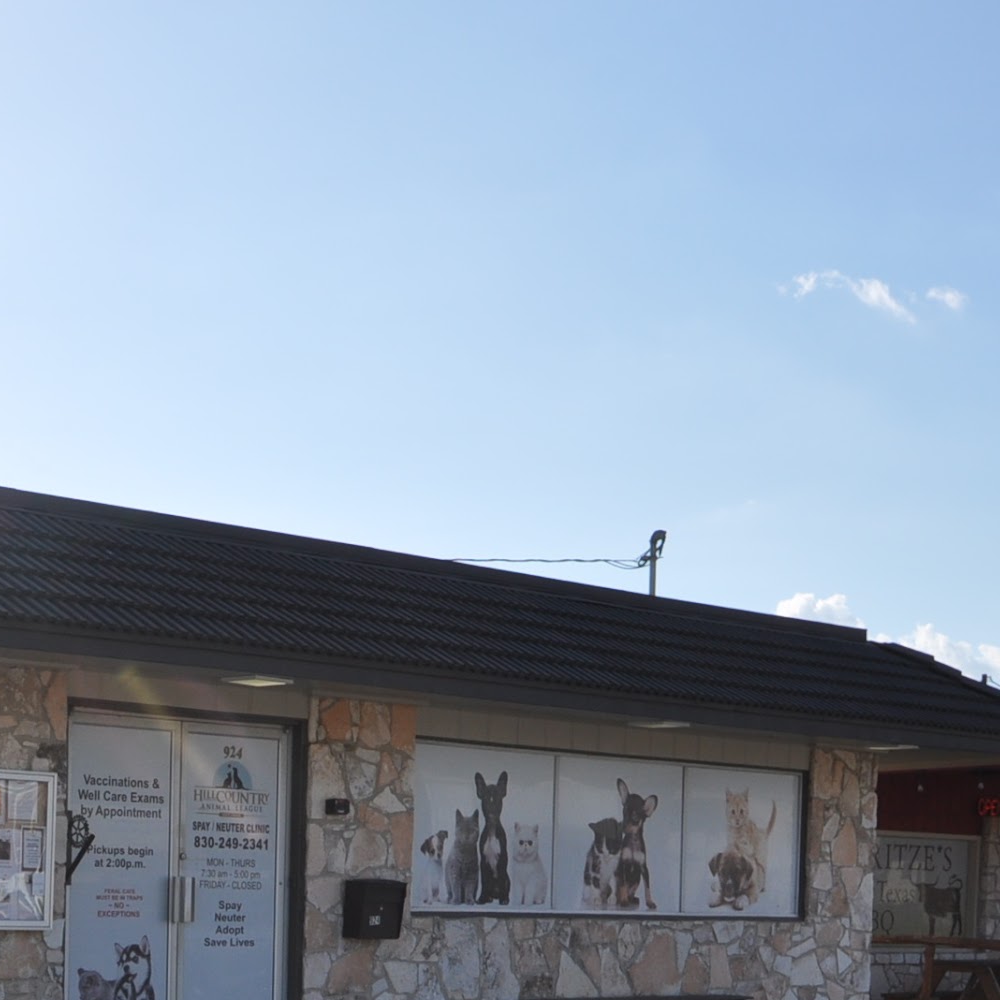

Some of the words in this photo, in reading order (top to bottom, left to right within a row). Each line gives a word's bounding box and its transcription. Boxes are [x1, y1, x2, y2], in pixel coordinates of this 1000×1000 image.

[223, 746, 242, 759] 924
[83, 774, 149, 788] Vaccinations
[152, 778, 160, 789] &
[78, 789, 100, 800] Well
[103, 790, 127, 802] Care
[130, 792, 164, 804] Exams
[80, 804, 93, 818] by
[96, 806, 162, 819] Appointment
[200, 803, 230, 811] ANIMAL
[192, 821, 210, 831] SPAY
[216, 822, 244, 833] NEUTER
[246, 824, 270, 834] CLINIC
[194, 836, 268, 850] 830-249-2341
[86, 844, 125, 856] Pickups
[128, 846, 154, 858] begin
[94, 859, 104, 868] at
[106, 858, 146, 870] 2:00p.m.
[206, 858, 224, 866] MON
[231, 859, 256, 868] THURS
[201, 869, 216, 877] 7:30
[234, 870, 248, 878] 5:00
[232, 881, 262, 890] CLOSED
[877, 880, 916, 904] Texas
[219, 901, 242, 911] Spay
[214, 913, 246, 922] Neuter
[215, 926, 244, 936] Adopt
[204, 938, 227, 947] Save
[230, 938, 255, 947] Lives
